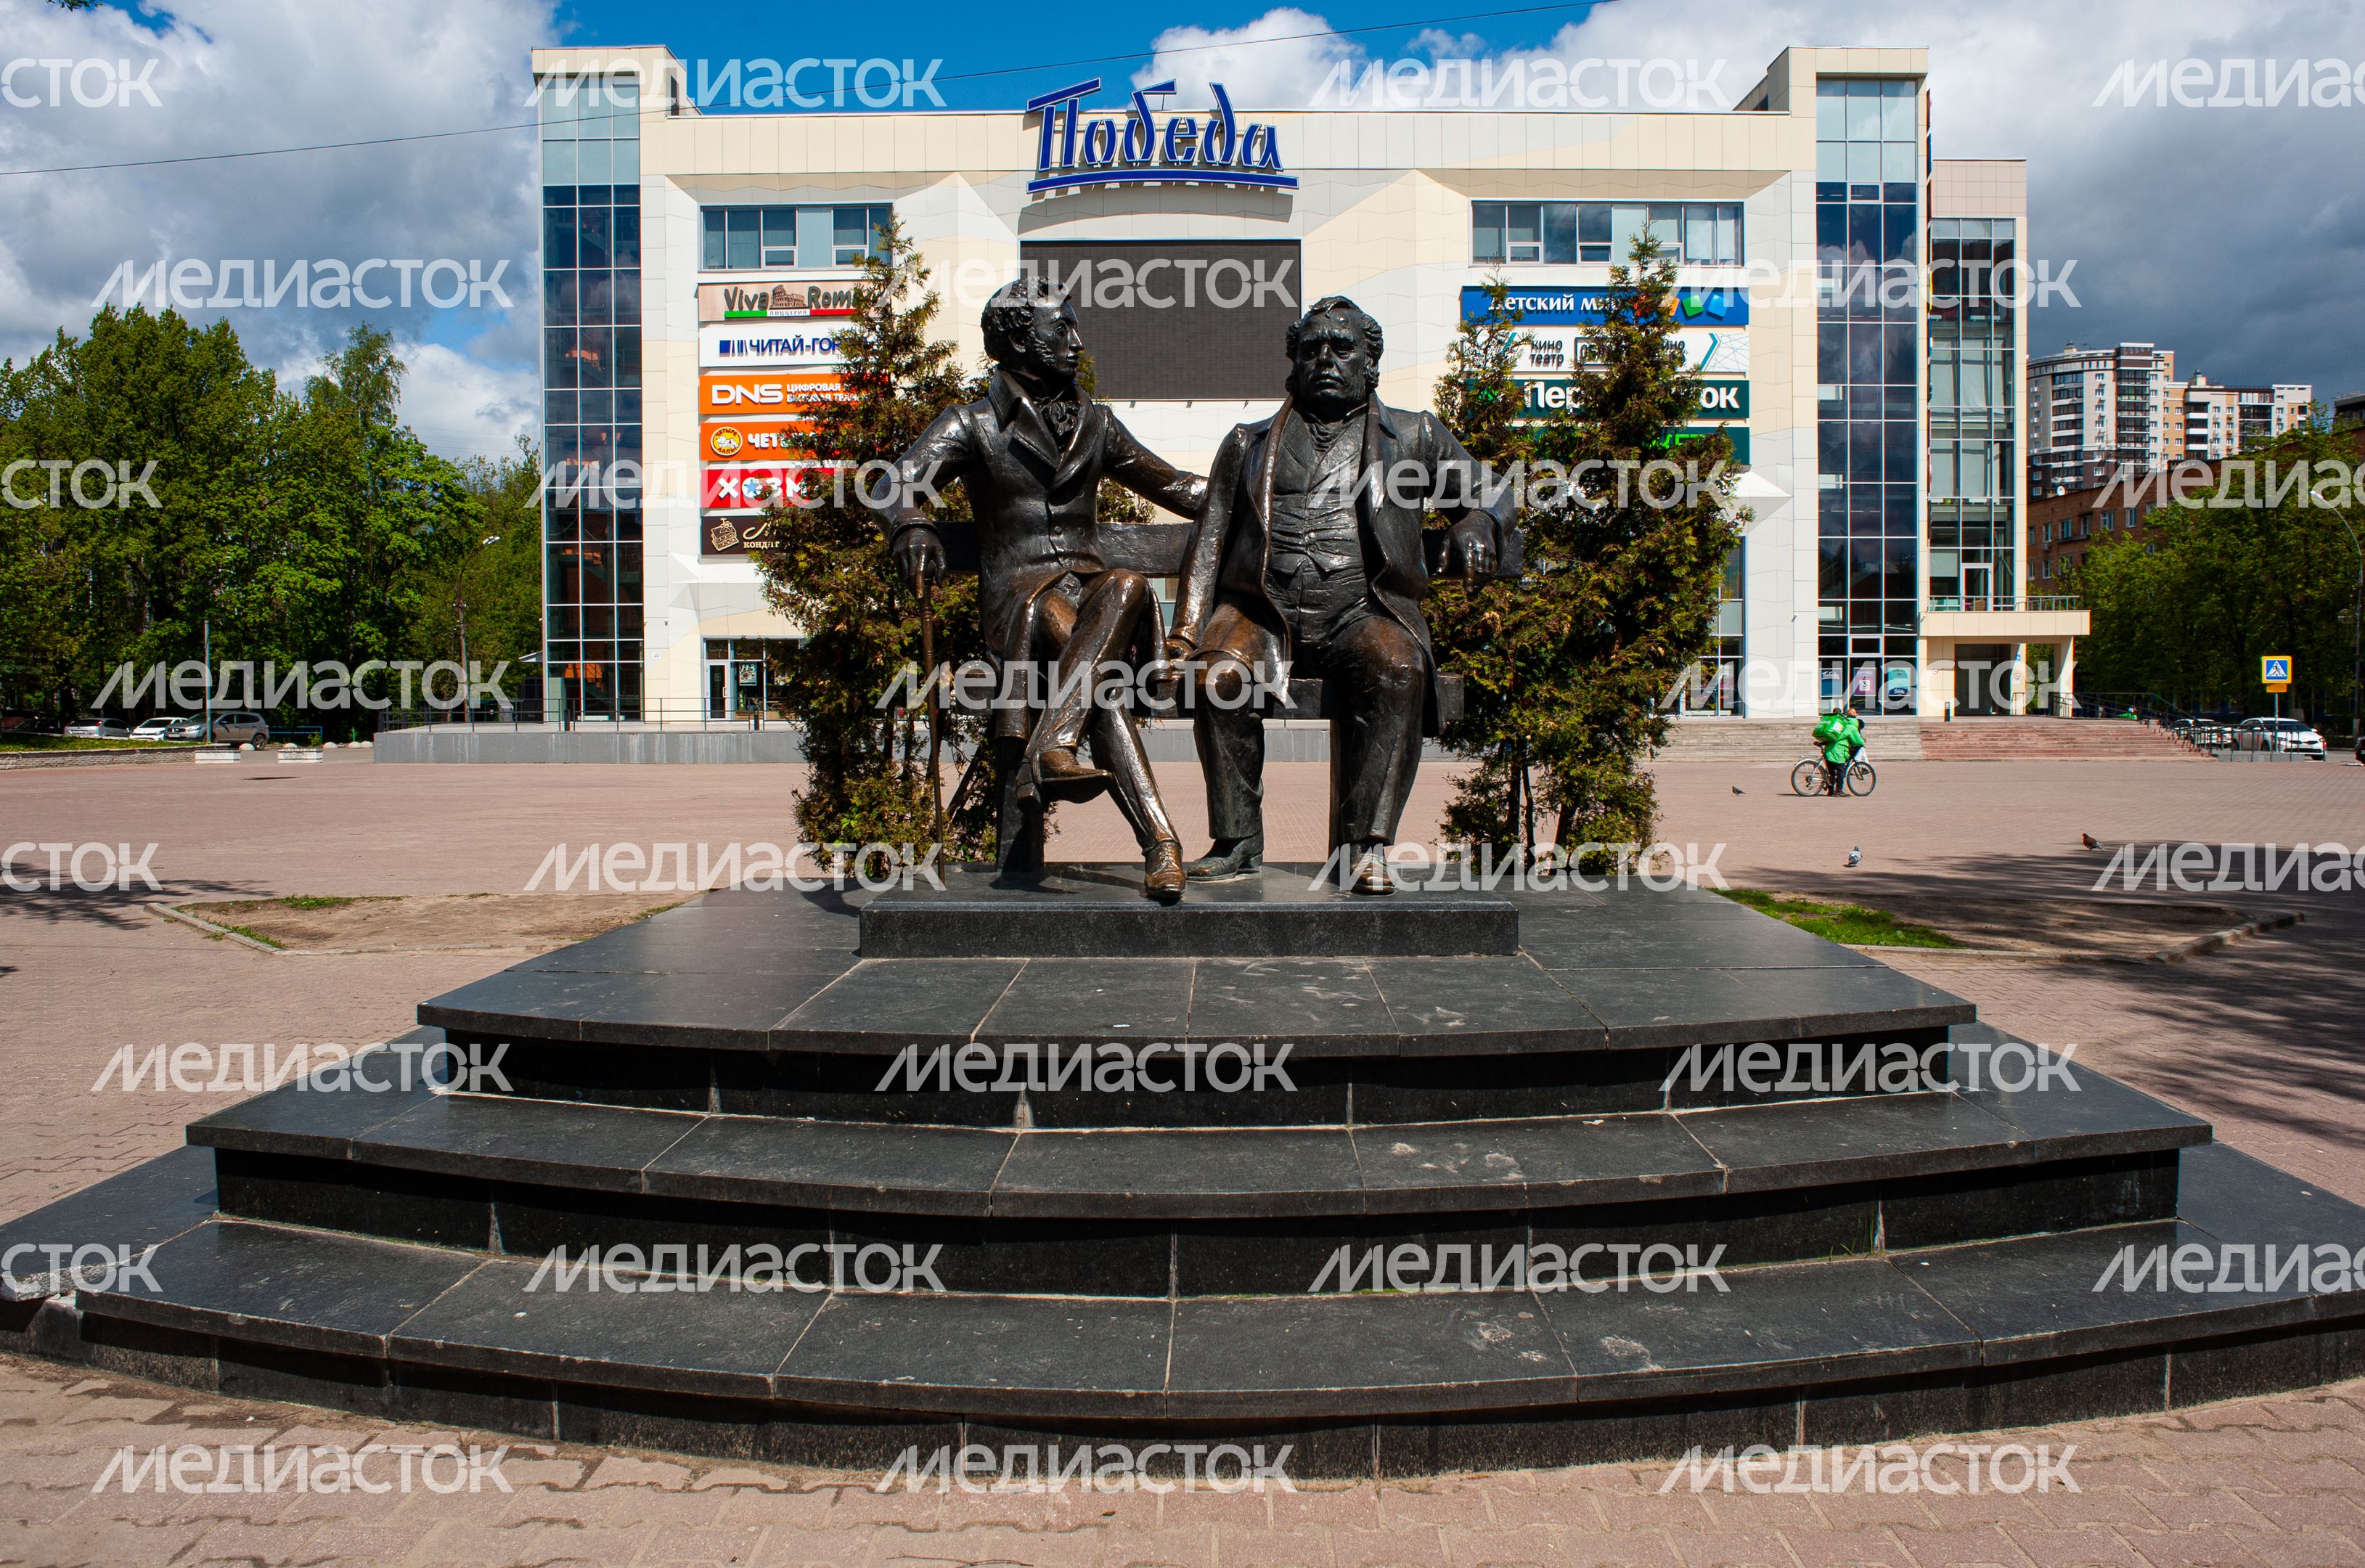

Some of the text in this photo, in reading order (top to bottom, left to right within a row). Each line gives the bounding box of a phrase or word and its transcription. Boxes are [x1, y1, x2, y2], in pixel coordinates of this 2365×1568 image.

[1026, 76, 1284, 172] Победа
[724, 286, 858, 310] Viva Rom
[749, 335, 867, 351] ЧИТАЙ-ГОР
[711, 384, 783, 404] DNS
[786, 383, 841, 393] ЦИФРОВАЯ
[748, 433, 817, 448] ЧЕТ
[718, 477, 813, 499] ХОЗМ
